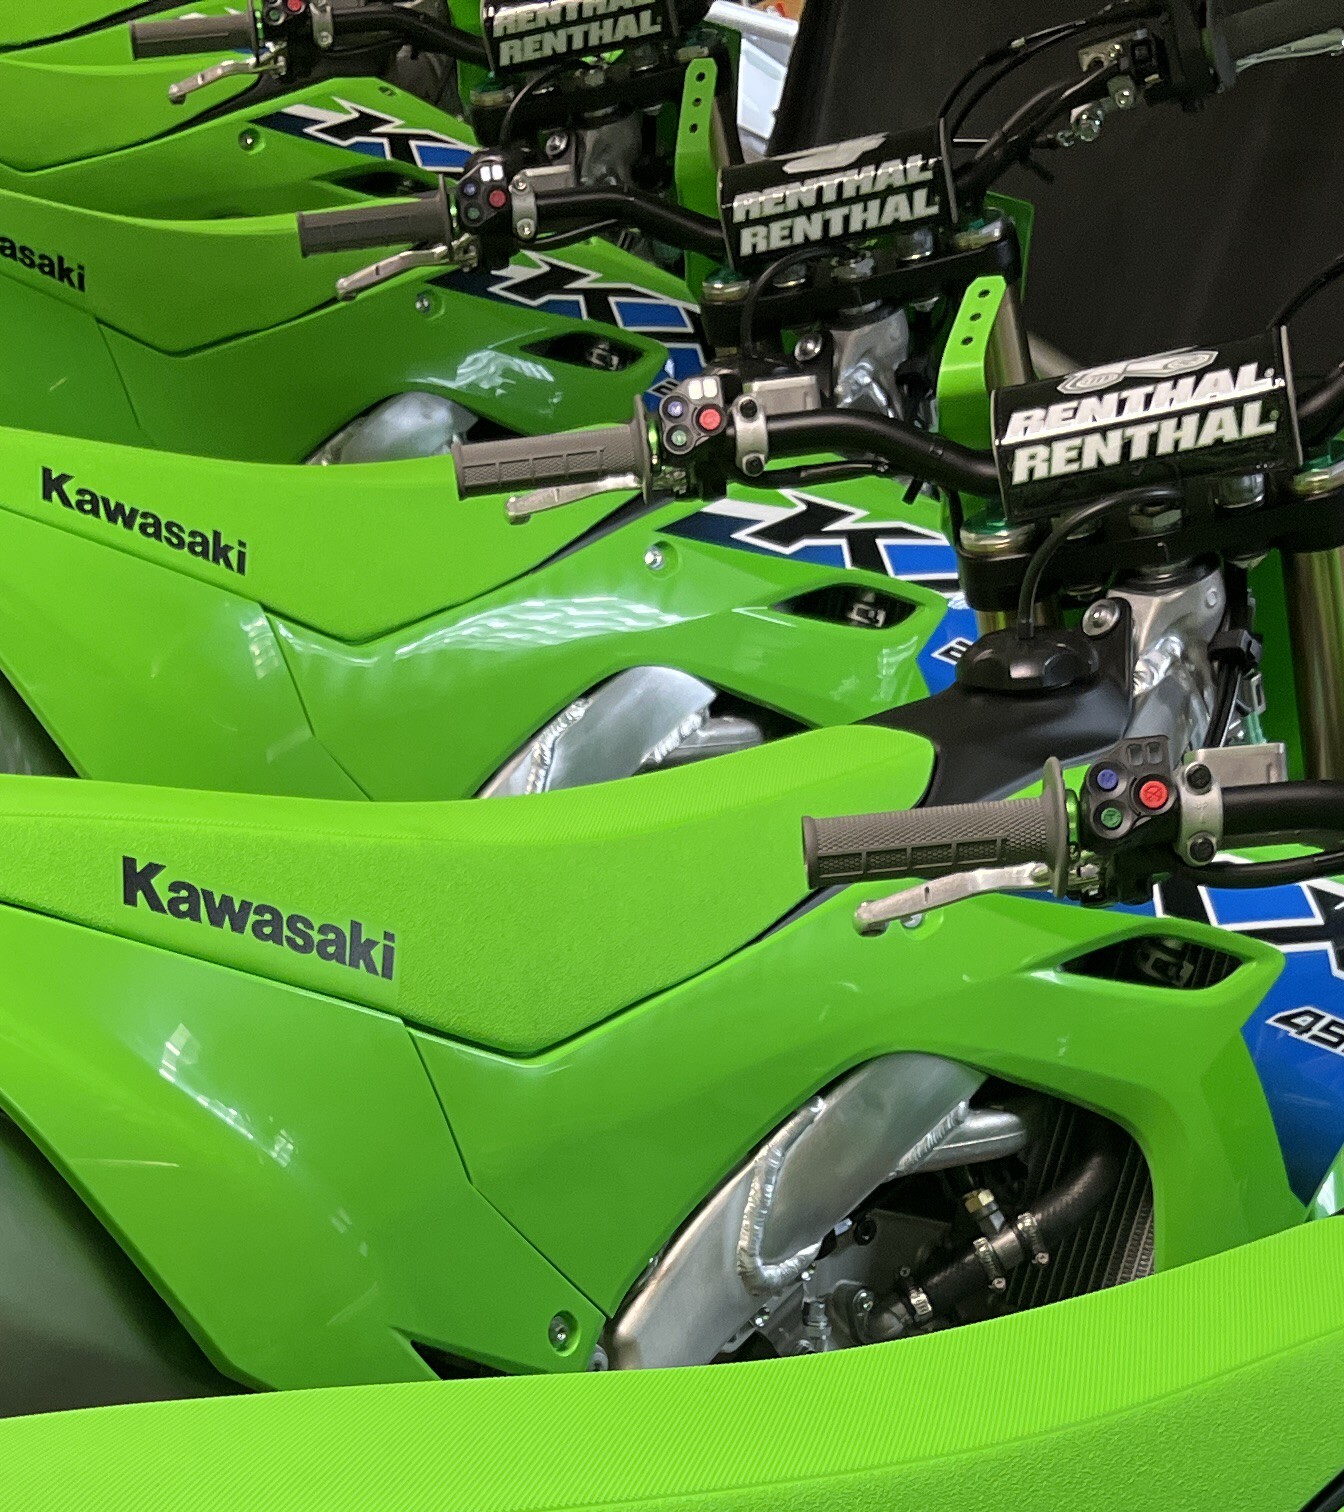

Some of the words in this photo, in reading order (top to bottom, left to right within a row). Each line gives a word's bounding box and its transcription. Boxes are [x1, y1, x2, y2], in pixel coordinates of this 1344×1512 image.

[499, 10, 661, 67] RENTHAL
[733, 154, 934, 224] RENTHAL
[739, 187, 940, 257] RENTHAL
[1005, 362, 1274, 442] RENTHAL
[1012, 400, 1277, 486] RENTHAL
[42, 465, 247, 576] Kawasaki
[122, 855, 395, 980] Kawasaki
